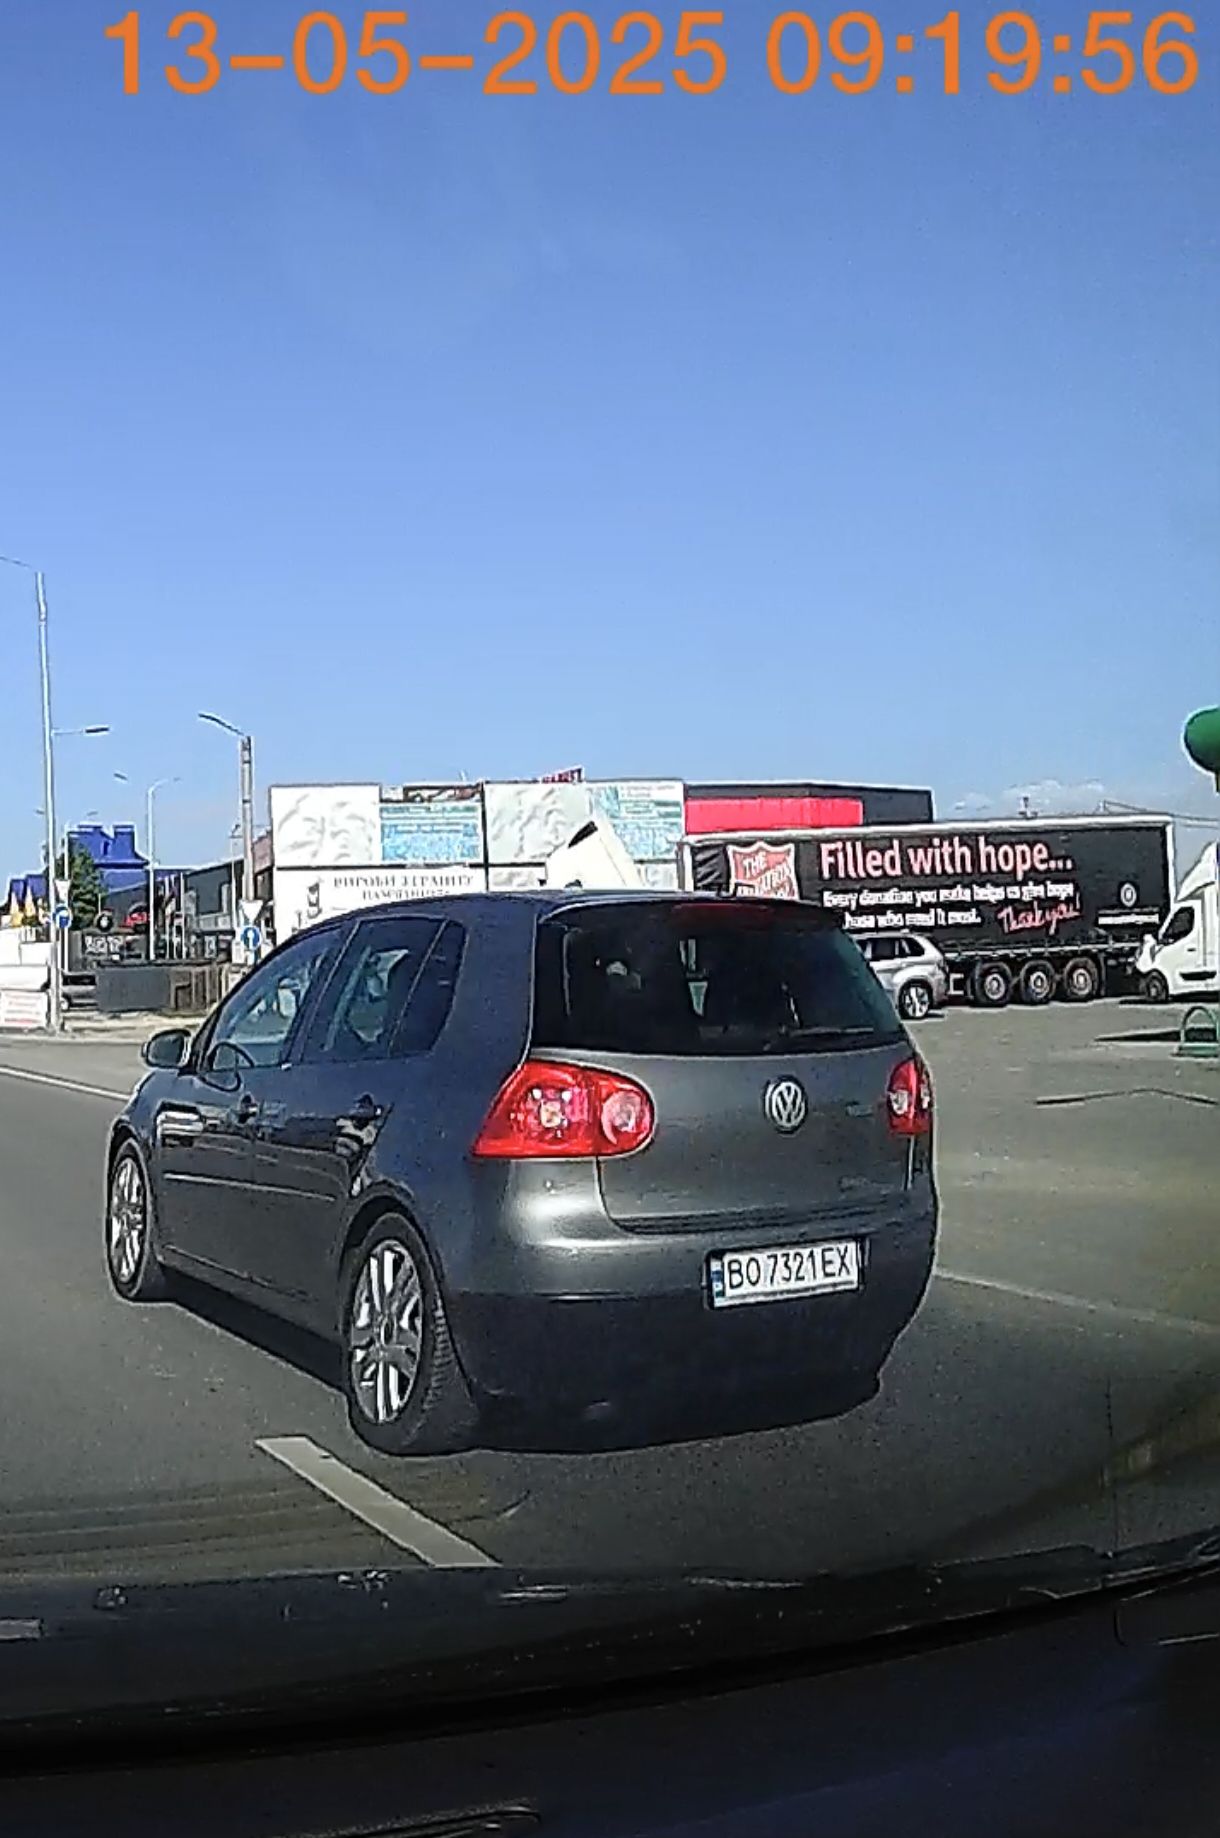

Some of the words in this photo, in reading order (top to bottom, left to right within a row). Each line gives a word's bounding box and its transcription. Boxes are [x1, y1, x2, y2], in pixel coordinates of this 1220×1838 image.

[743, 851, 768, 878] THE
[820, 839, 902, 879] Filled
[907, 836, 972, 875] with
[978, 835, 1073, 881] hope...
